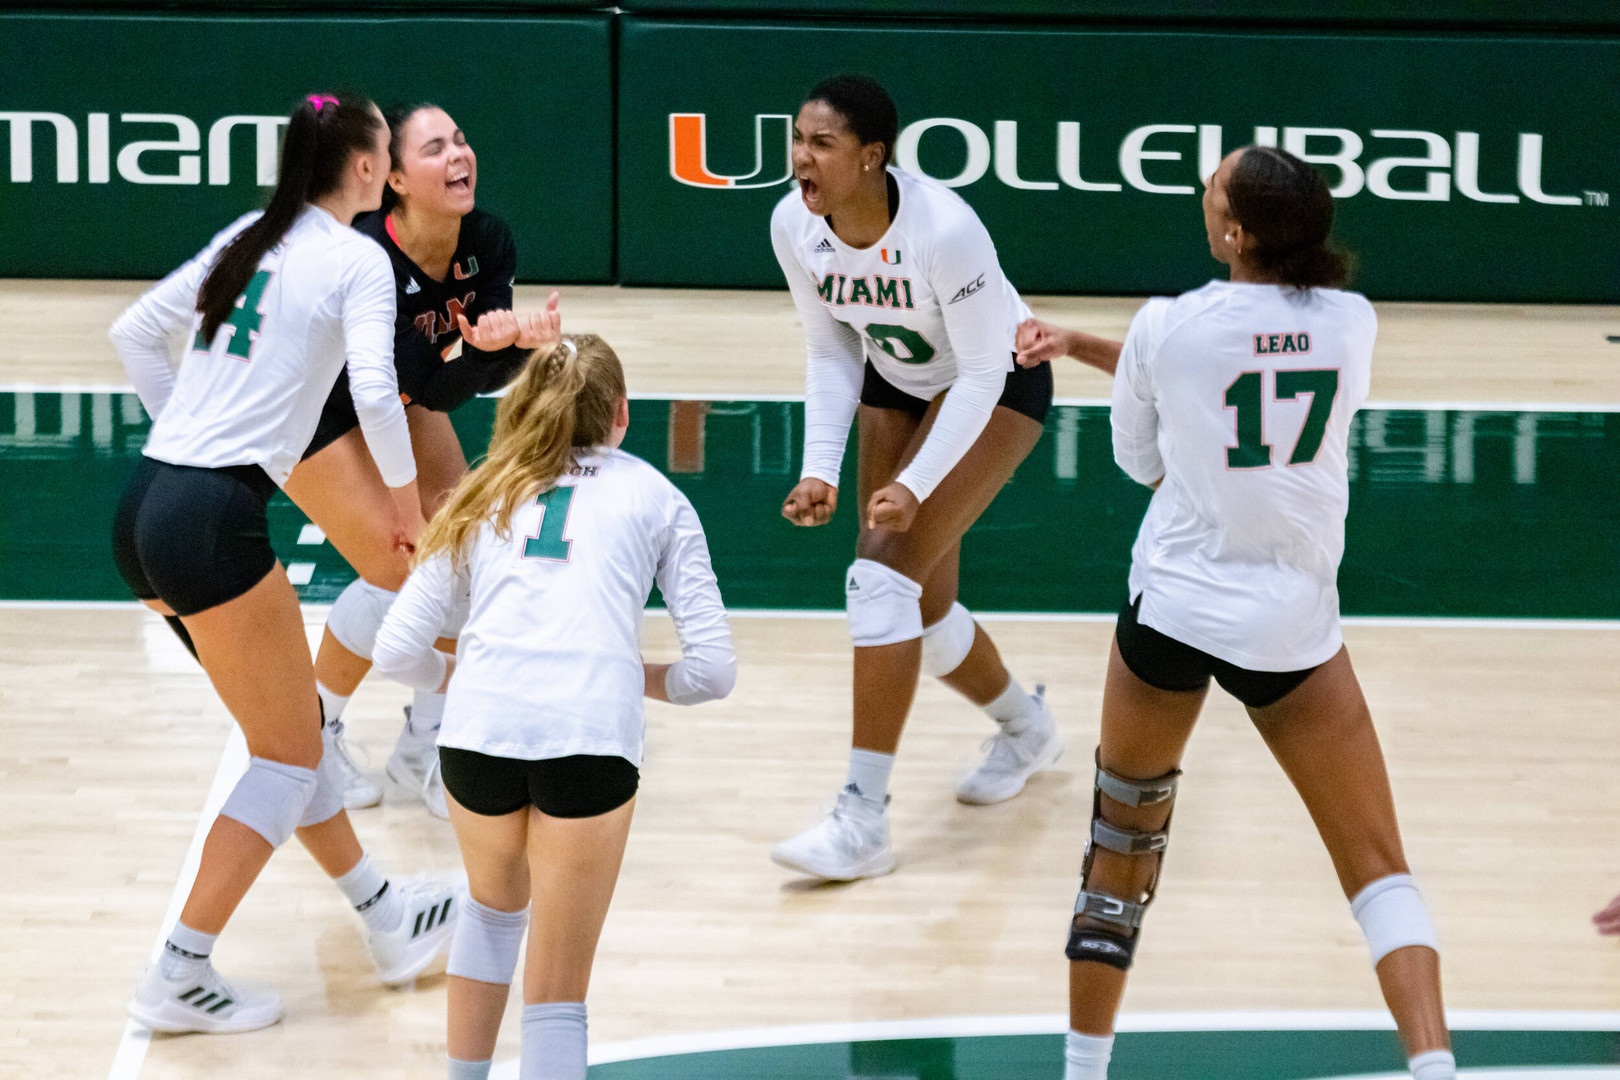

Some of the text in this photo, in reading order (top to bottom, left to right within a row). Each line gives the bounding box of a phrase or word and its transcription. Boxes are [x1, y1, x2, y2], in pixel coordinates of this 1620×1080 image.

[0, 111, 291, 185] MIAM
[669, 113, 793, 189] U
[896, 118, 1583, 206] OLLEBALL
[191, 268, 277, 363] 4
[813, 272, 916, 311] MIAMI
[949, 273, 986, 304] ACC
[836, 322, 938, 364] 0
[1253, 332, 1312, 358] LEAO
[1222, 368, 1341, 472] 17
[521, 484, 578, 563] 1
